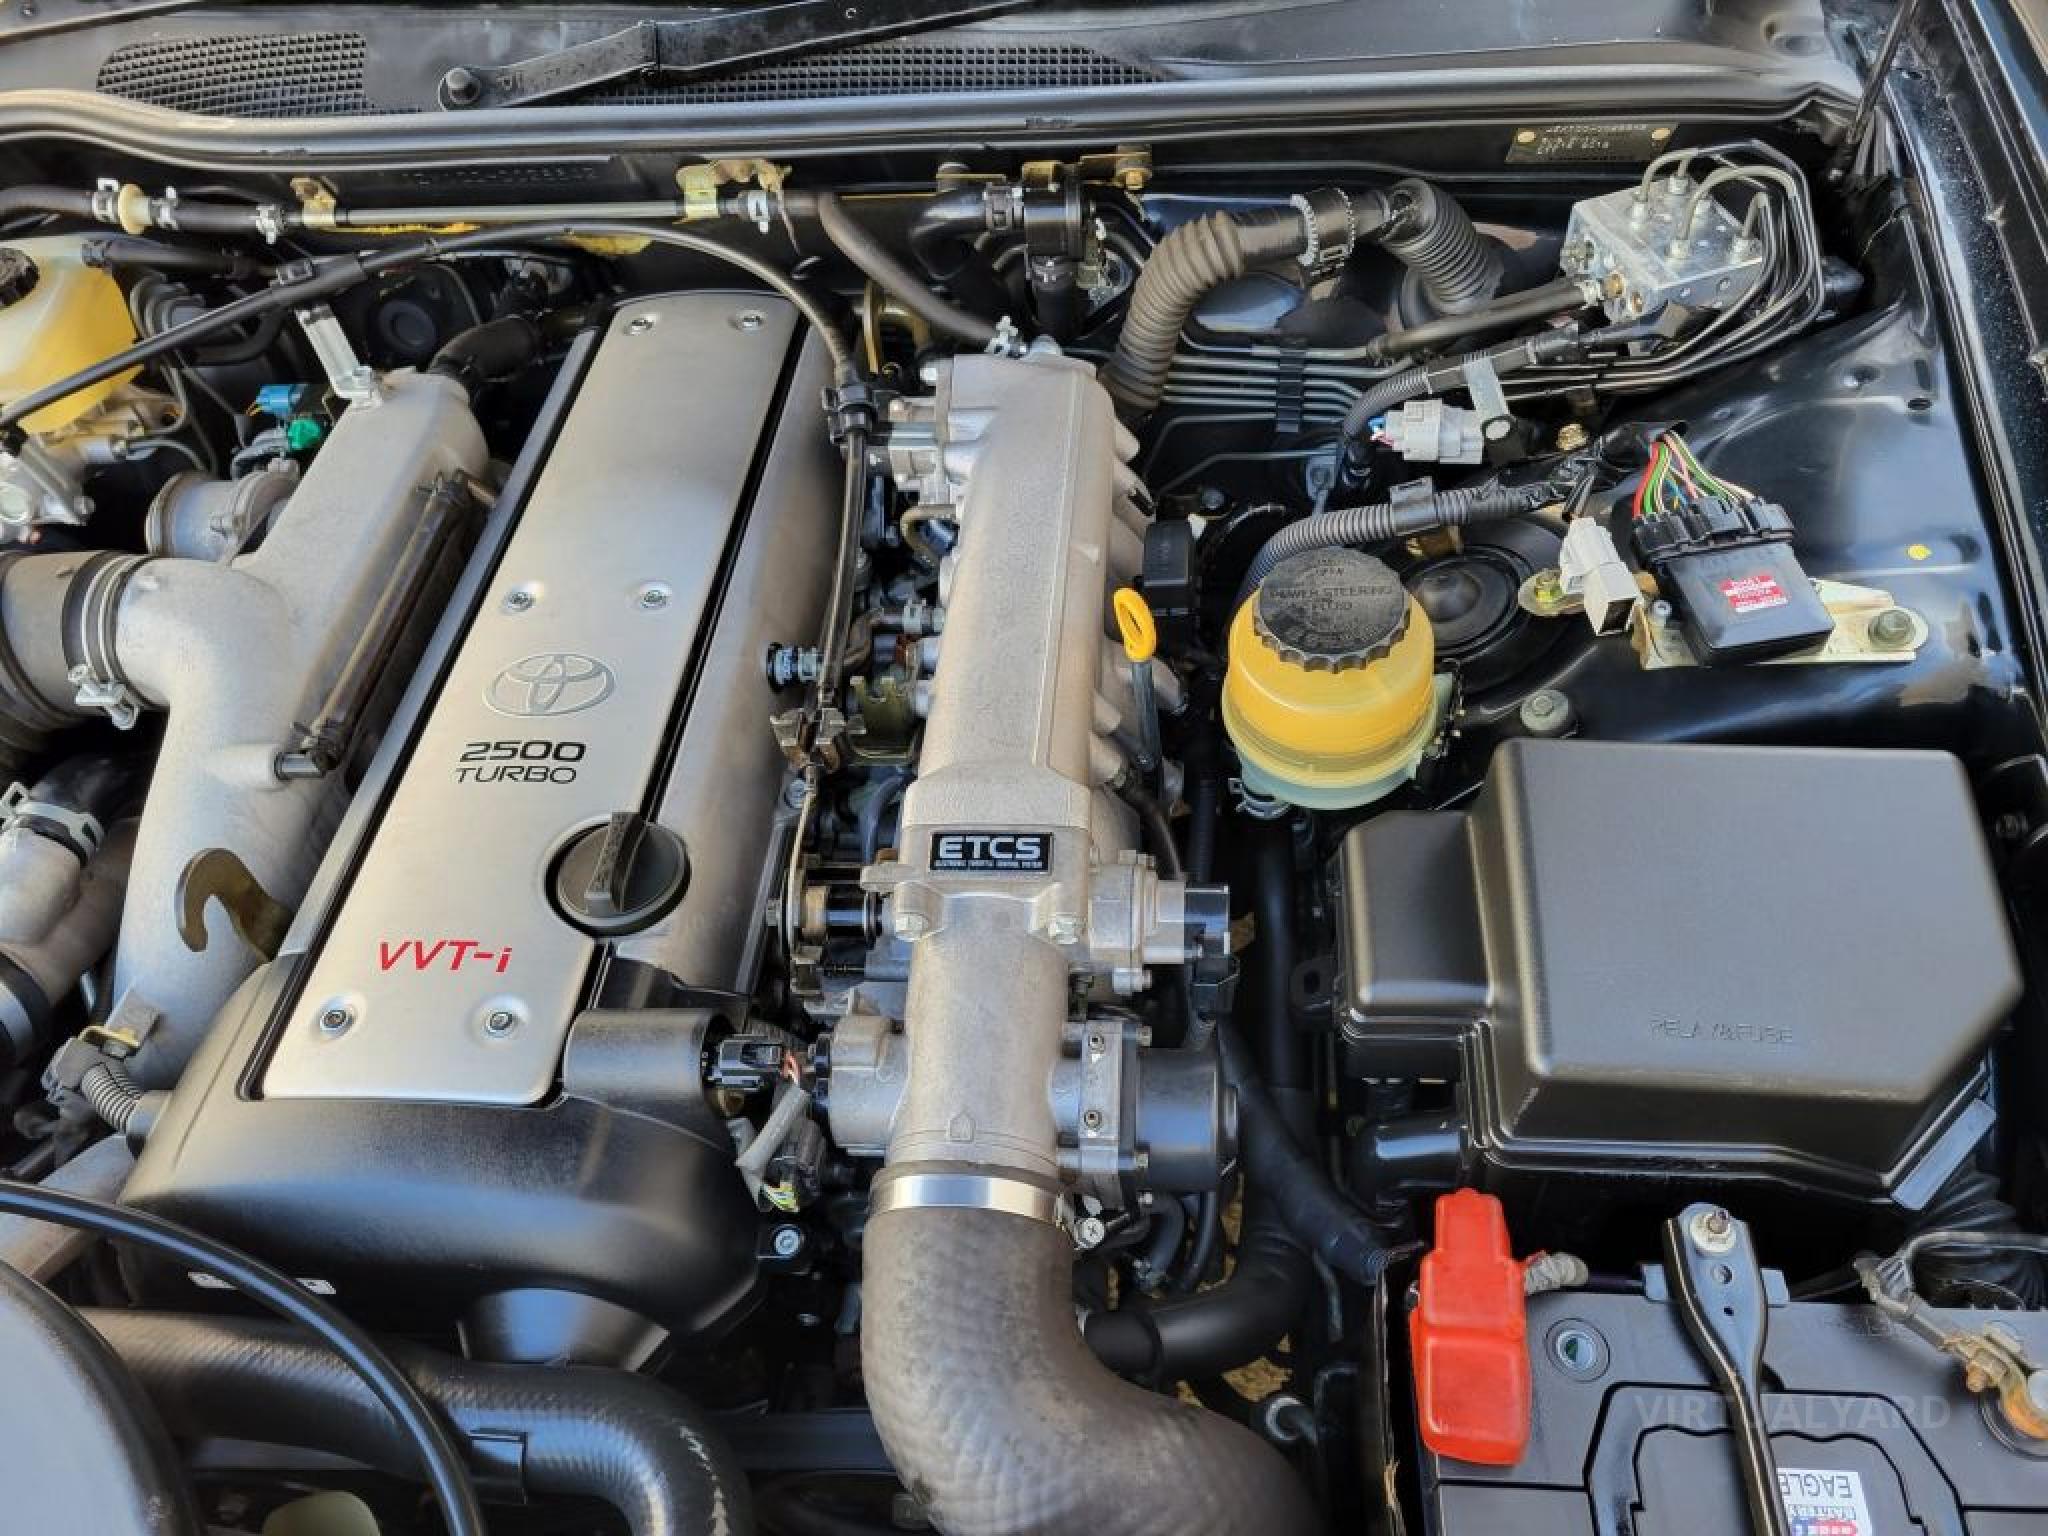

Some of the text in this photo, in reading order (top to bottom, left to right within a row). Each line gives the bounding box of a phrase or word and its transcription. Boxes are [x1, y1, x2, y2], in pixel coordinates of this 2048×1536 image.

[459, 740, 587, 762] 2500
[455, 766, 577, 784] TURBO
[939, 836, 1041, 859] ETCS
[380, 940, 513, 973] VVT-i
[1778, 1473, 1853, 1498] EAGLE
